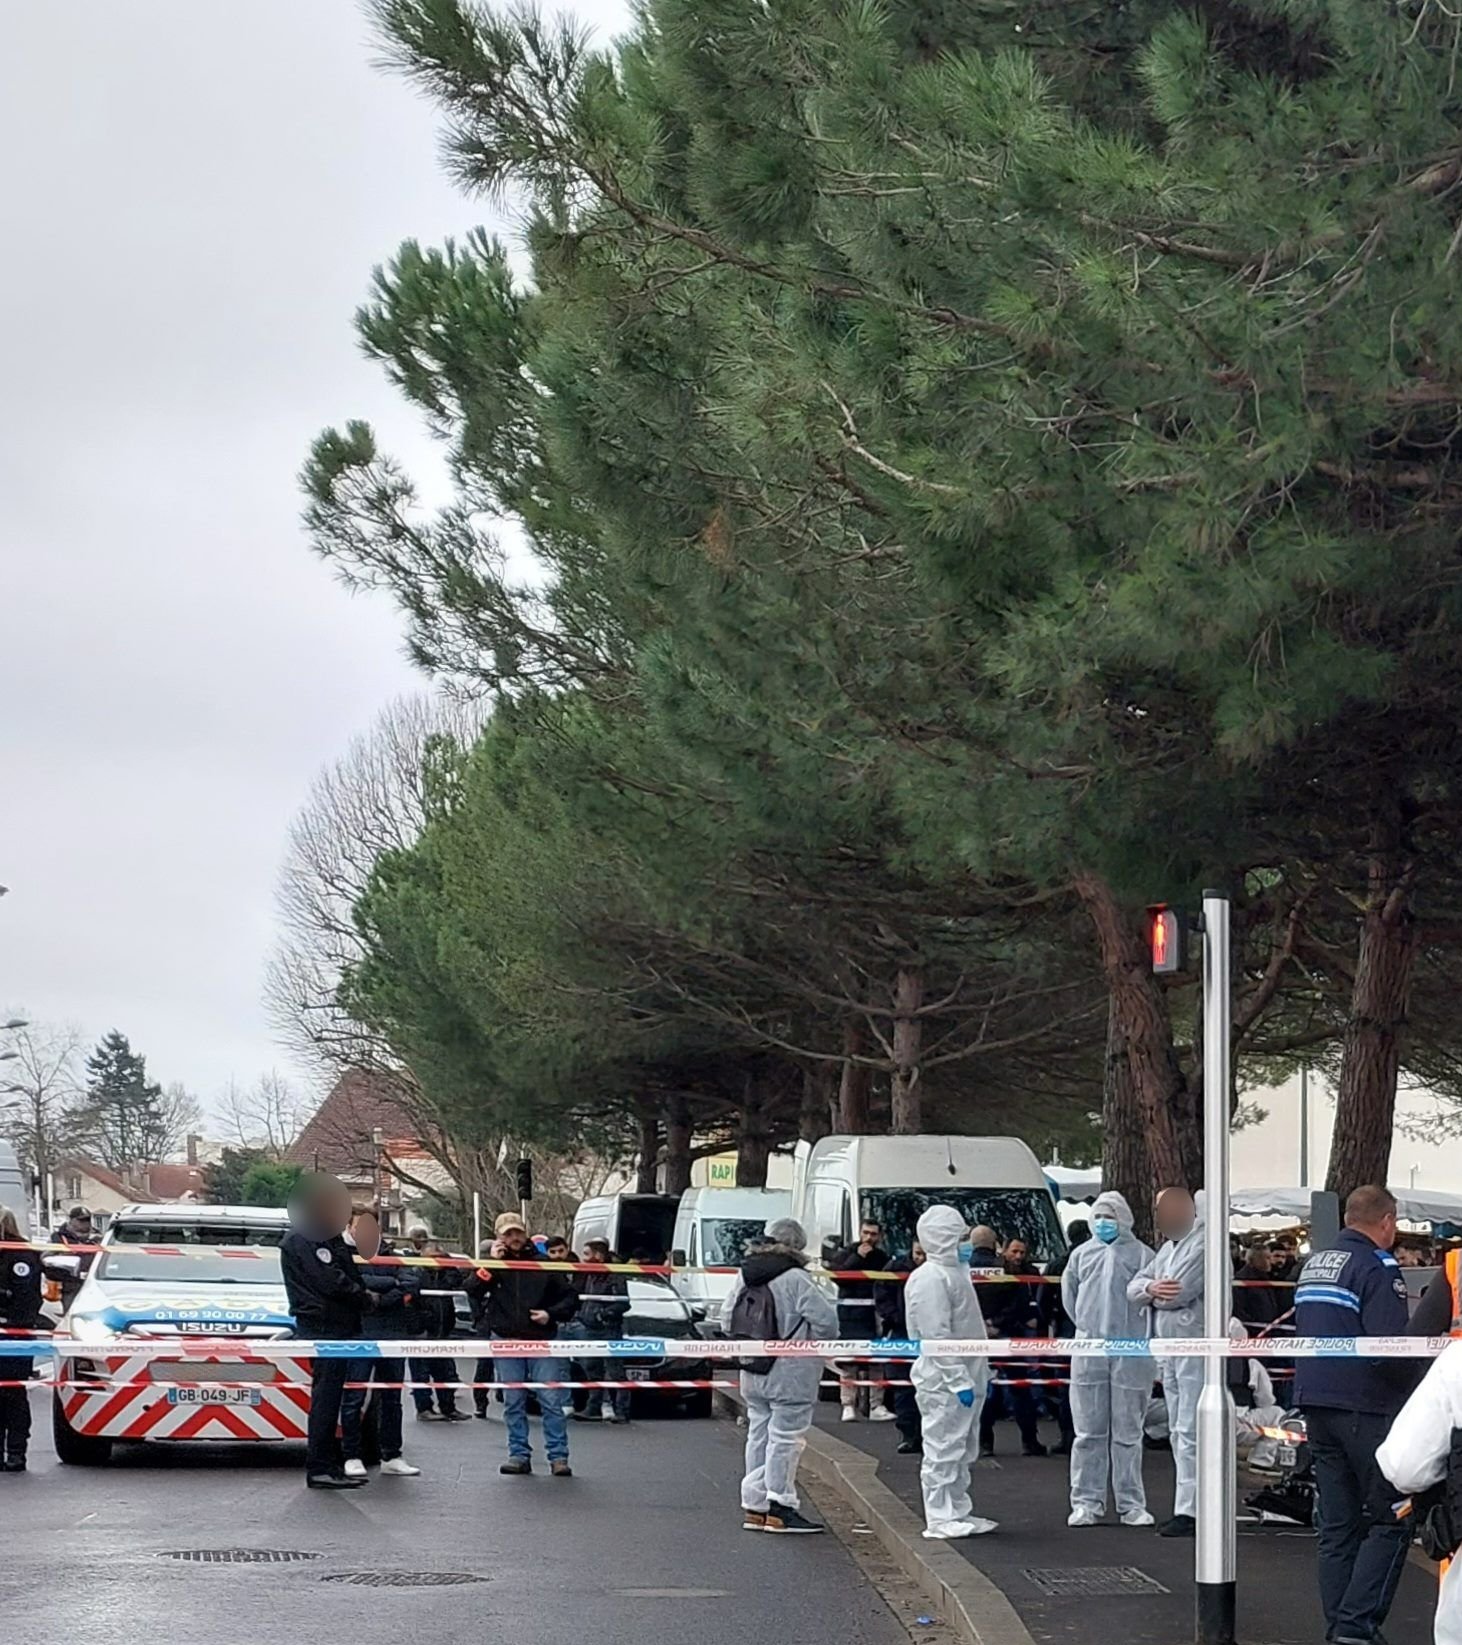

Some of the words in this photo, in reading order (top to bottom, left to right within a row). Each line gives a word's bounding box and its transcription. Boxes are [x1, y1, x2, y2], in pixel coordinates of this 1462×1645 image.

[155, 1311, 173, 1320] 01
[179, 1311, 197, 1320] 69
[202, 1311, 222, 1320] 90
[226, 1312, 245, 1320] 00
[250, 1312, 268, 1321] 77
[182, 1322, 242, 1332] ISUZU
